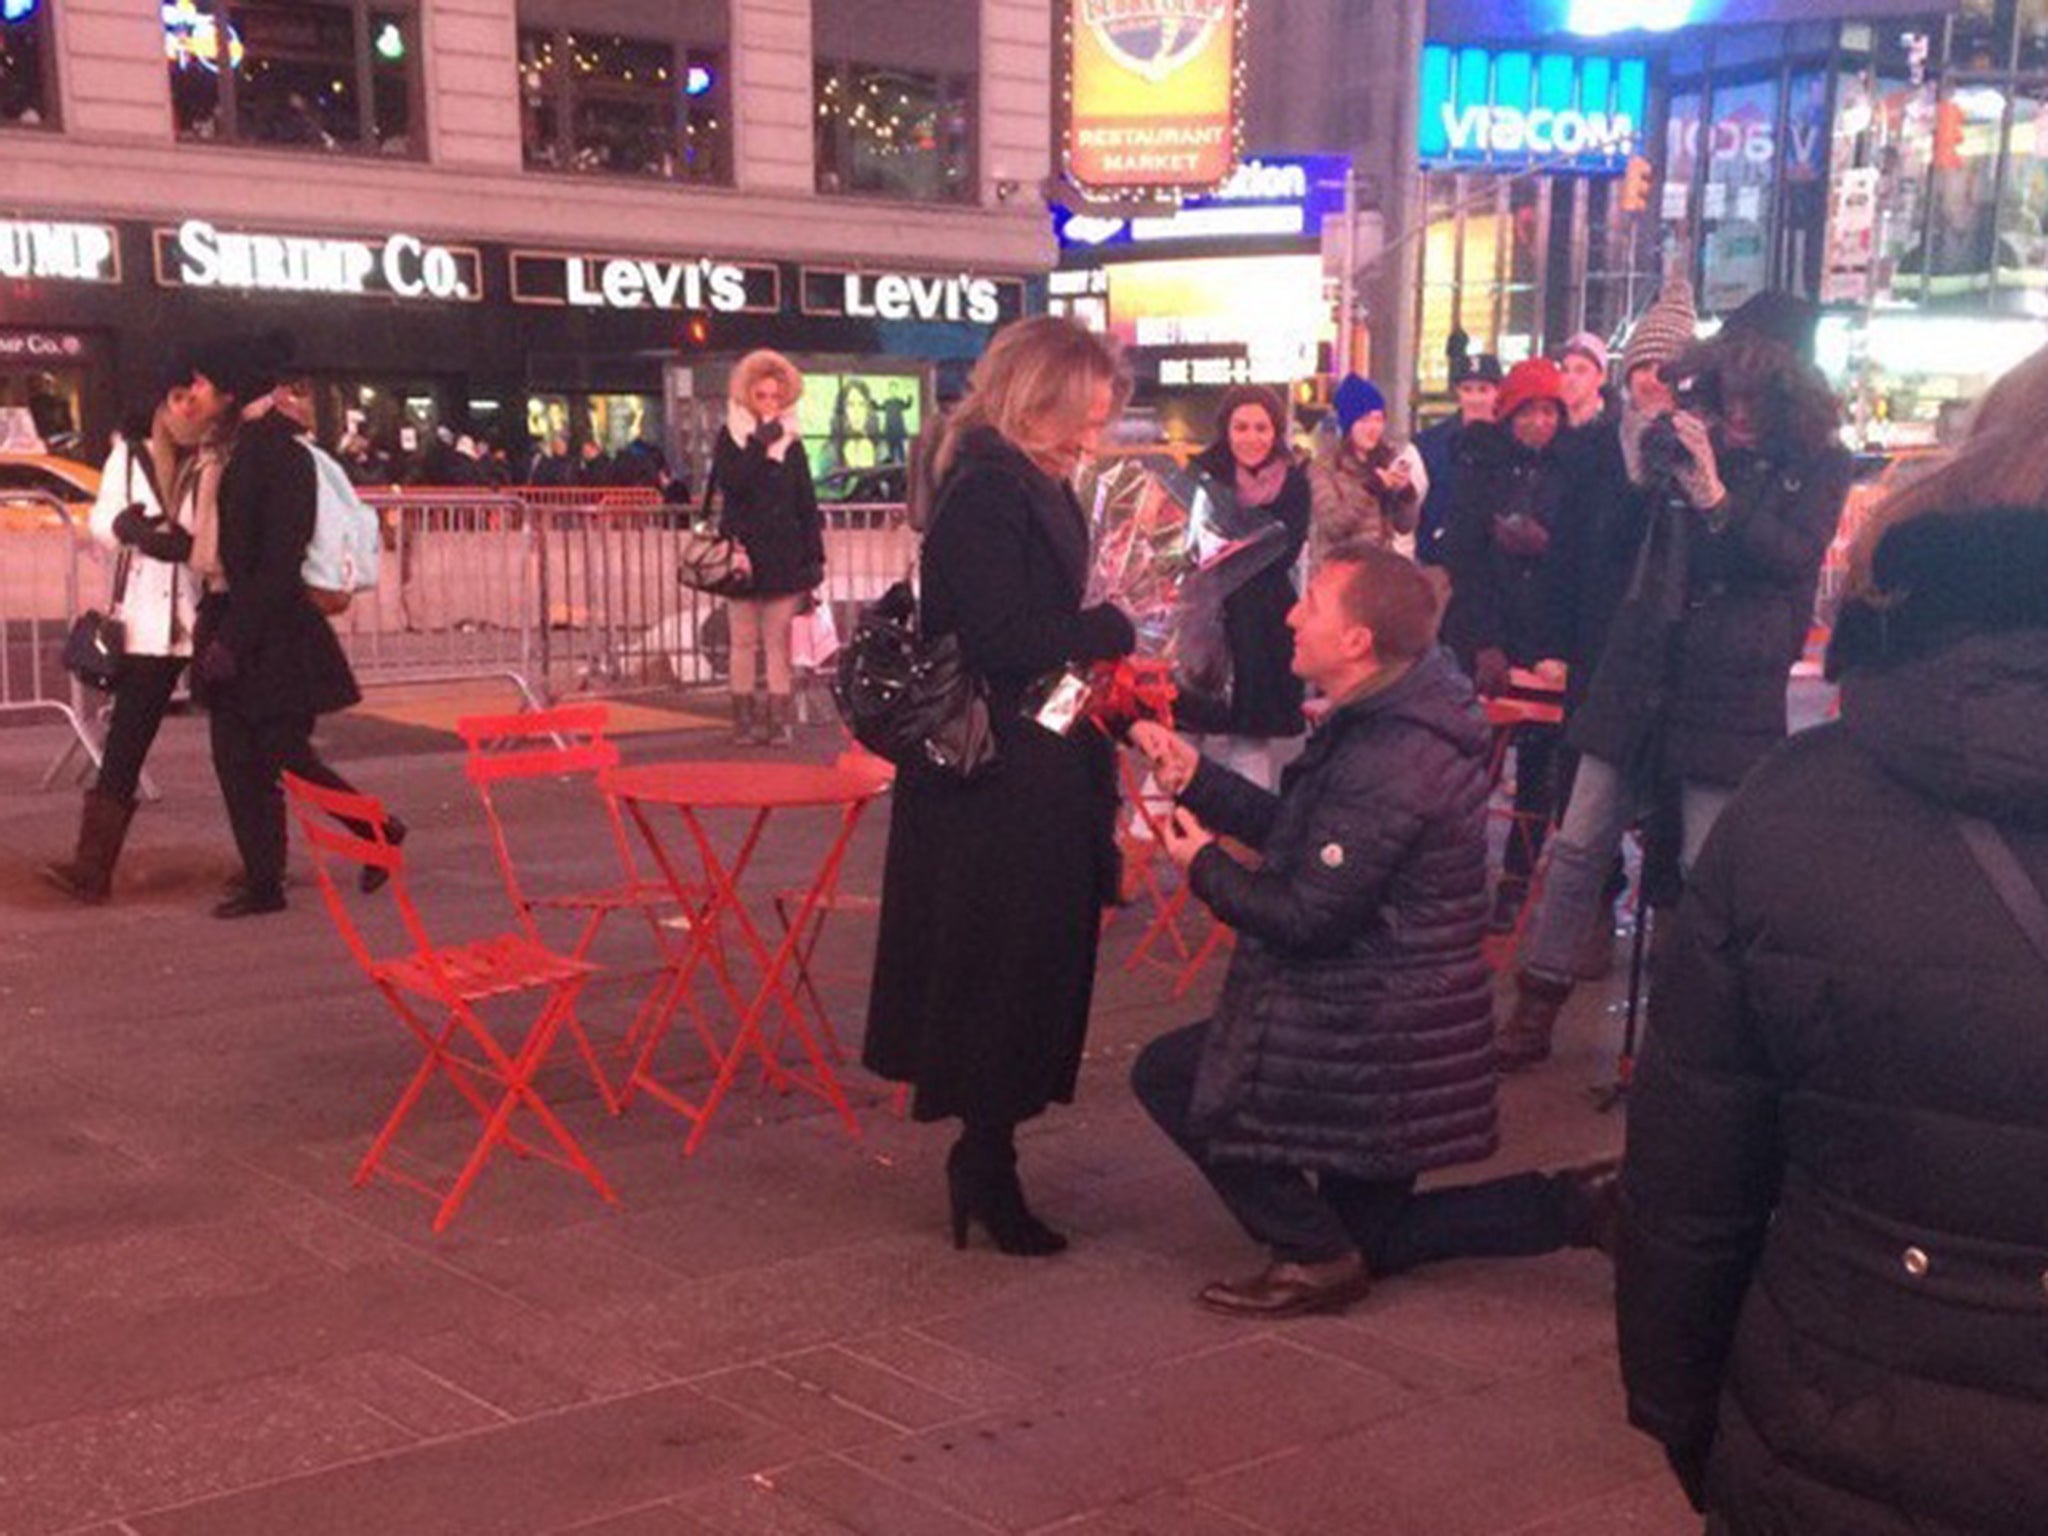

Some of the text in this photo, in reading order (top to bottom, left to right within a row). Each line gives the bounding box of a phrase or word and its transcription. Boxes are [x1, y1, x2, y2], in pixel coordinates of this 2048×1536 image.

[1077, 126, 1224, 147] RESTAURANT
[1102, 152, 1199, 172] MARKET
[179, 219, 373, 293] SHRIMP
